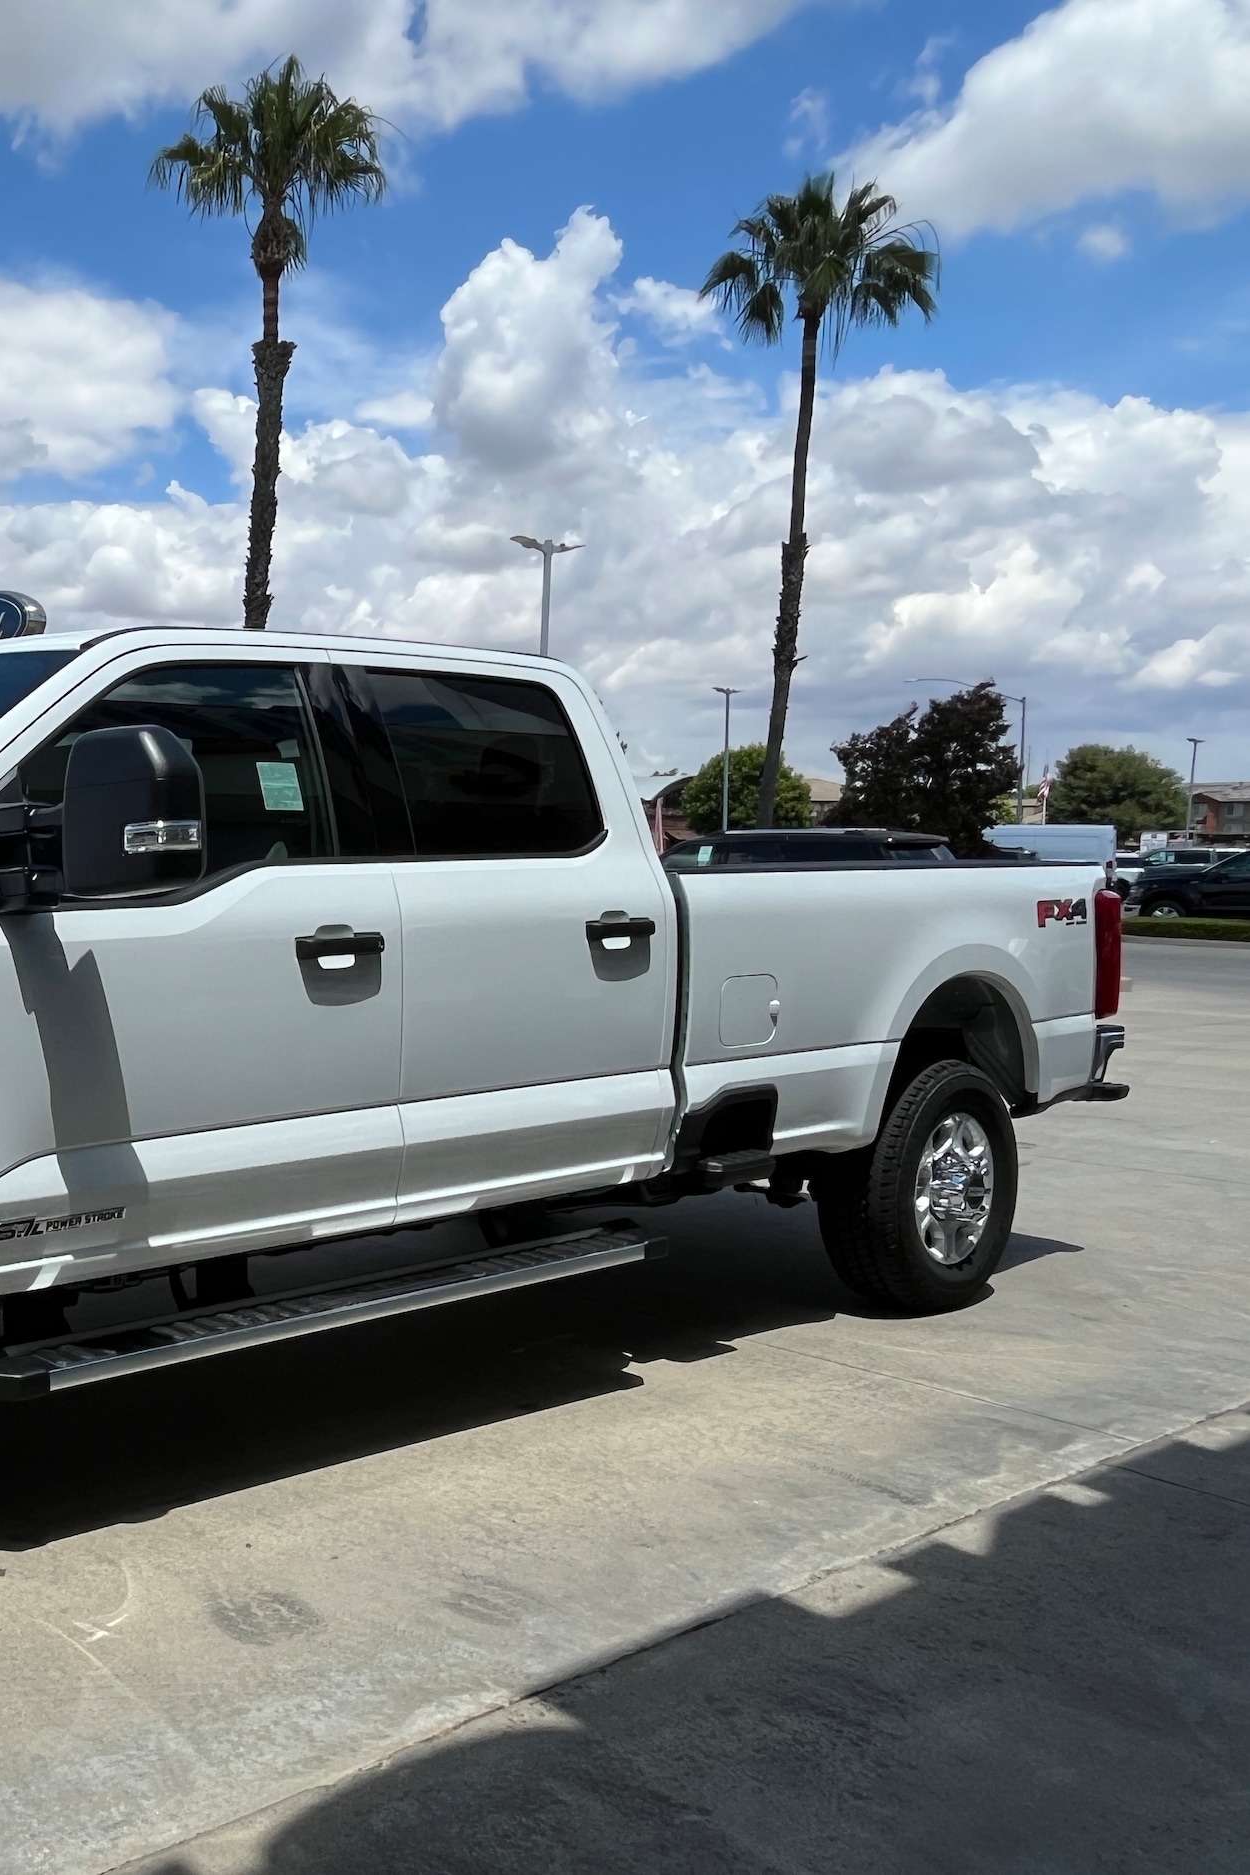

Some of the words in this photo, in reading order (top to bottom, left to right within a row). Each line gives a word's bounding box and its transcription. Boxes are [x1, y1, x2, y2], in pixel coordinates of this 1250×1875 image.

[1037, 898, 1087, 927] FX4
[45, 1216, 82, 1232] POWER
[84, 1209, 124, 1225] STROKE
